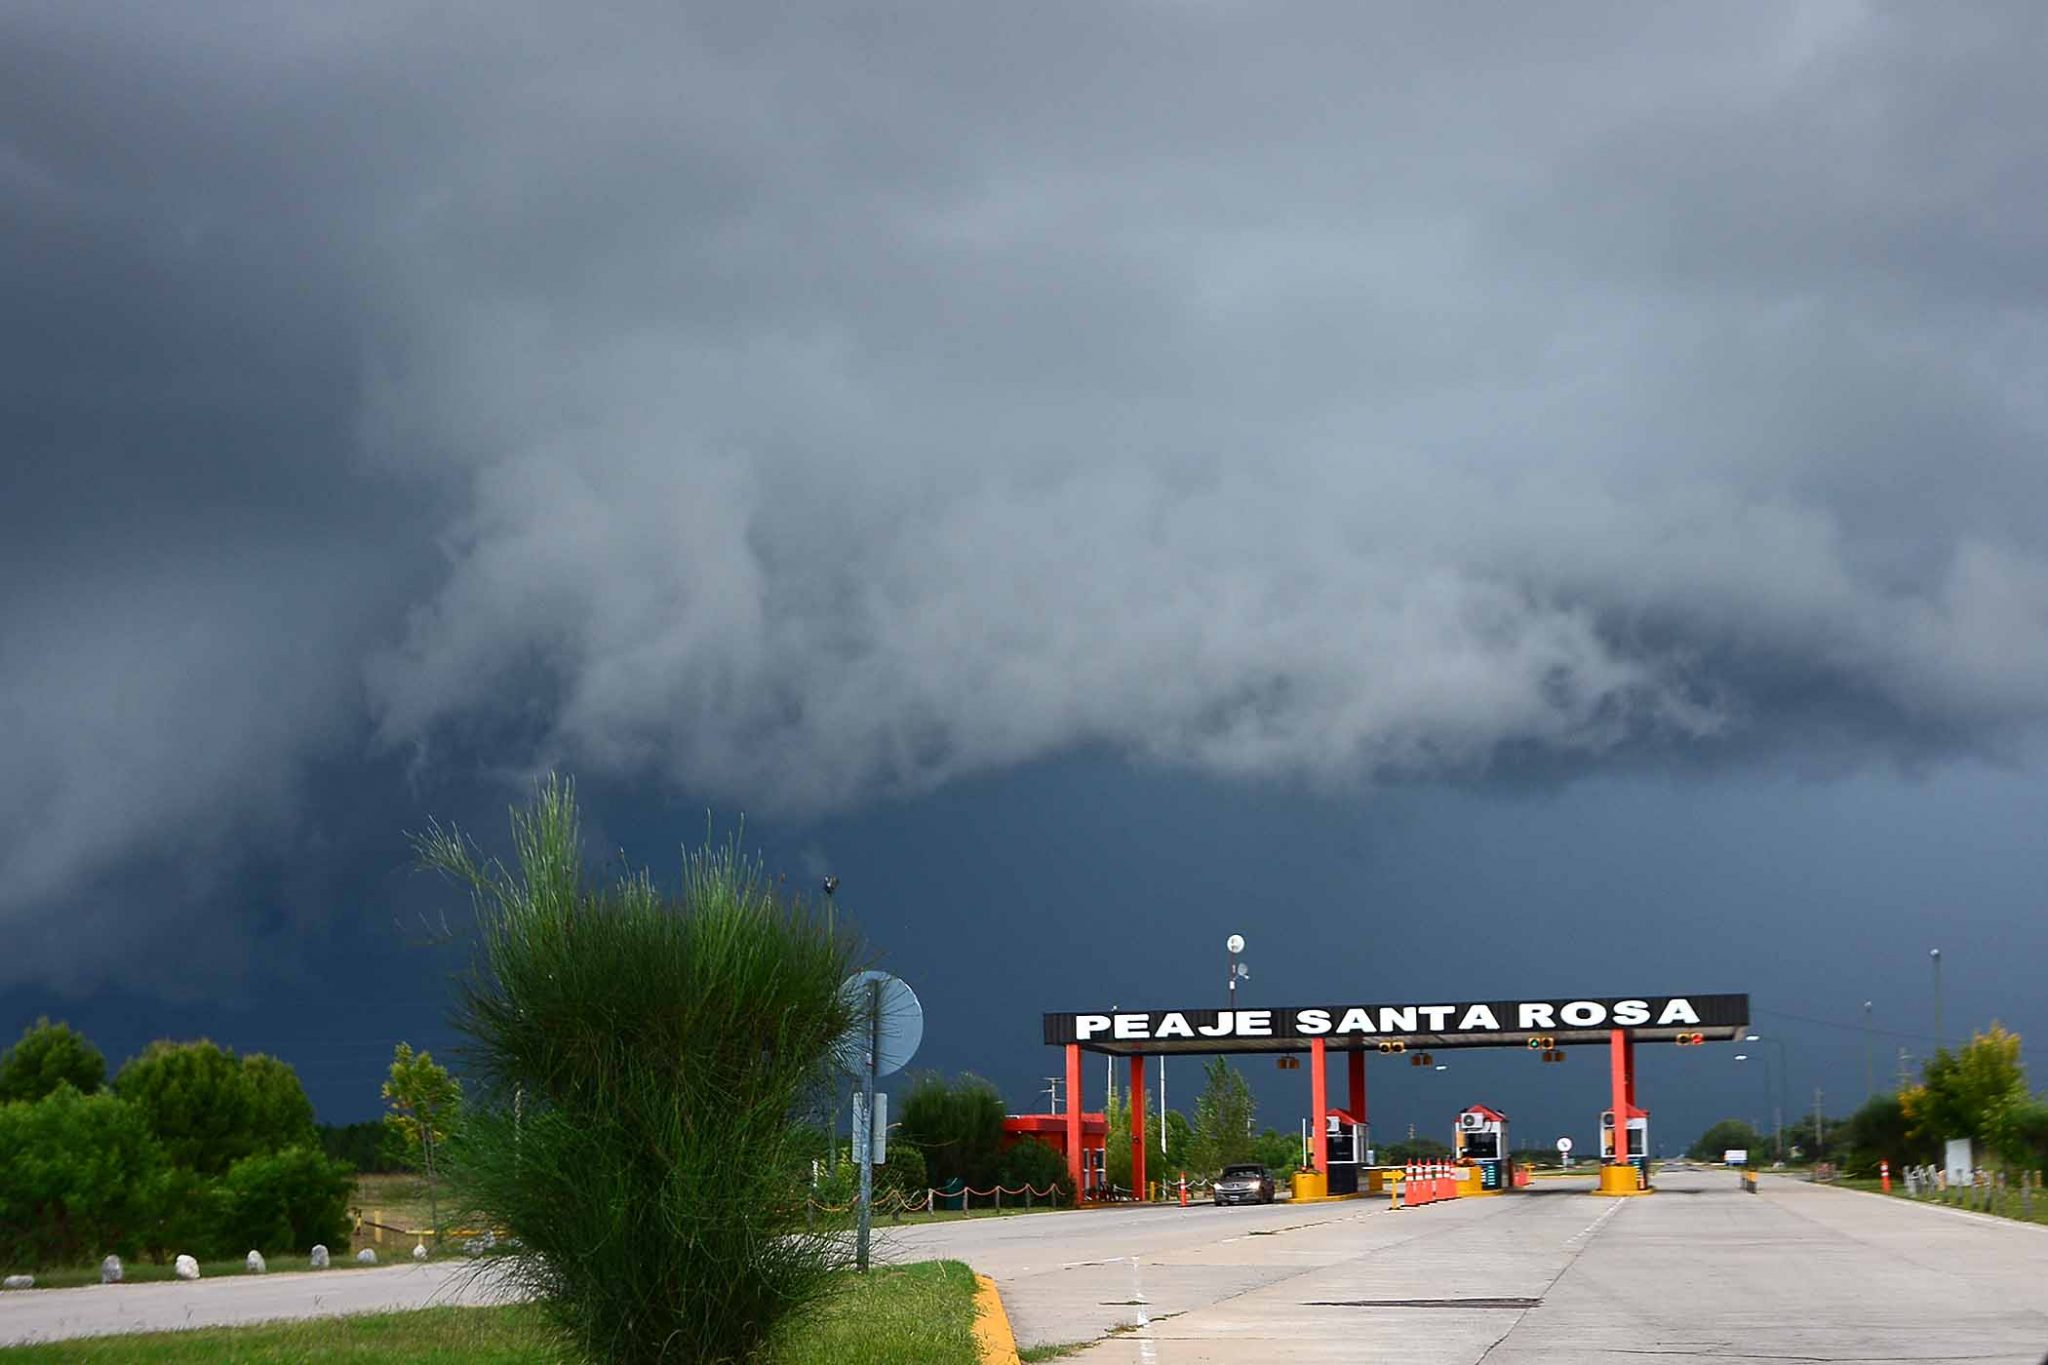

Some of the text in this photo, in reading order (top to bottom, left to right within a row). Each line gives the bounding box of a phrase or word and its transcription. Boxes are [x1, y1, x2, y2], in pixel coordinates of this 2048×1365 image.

[1075, 998, 1701, 1040] PEAJE SANTA ROSA
